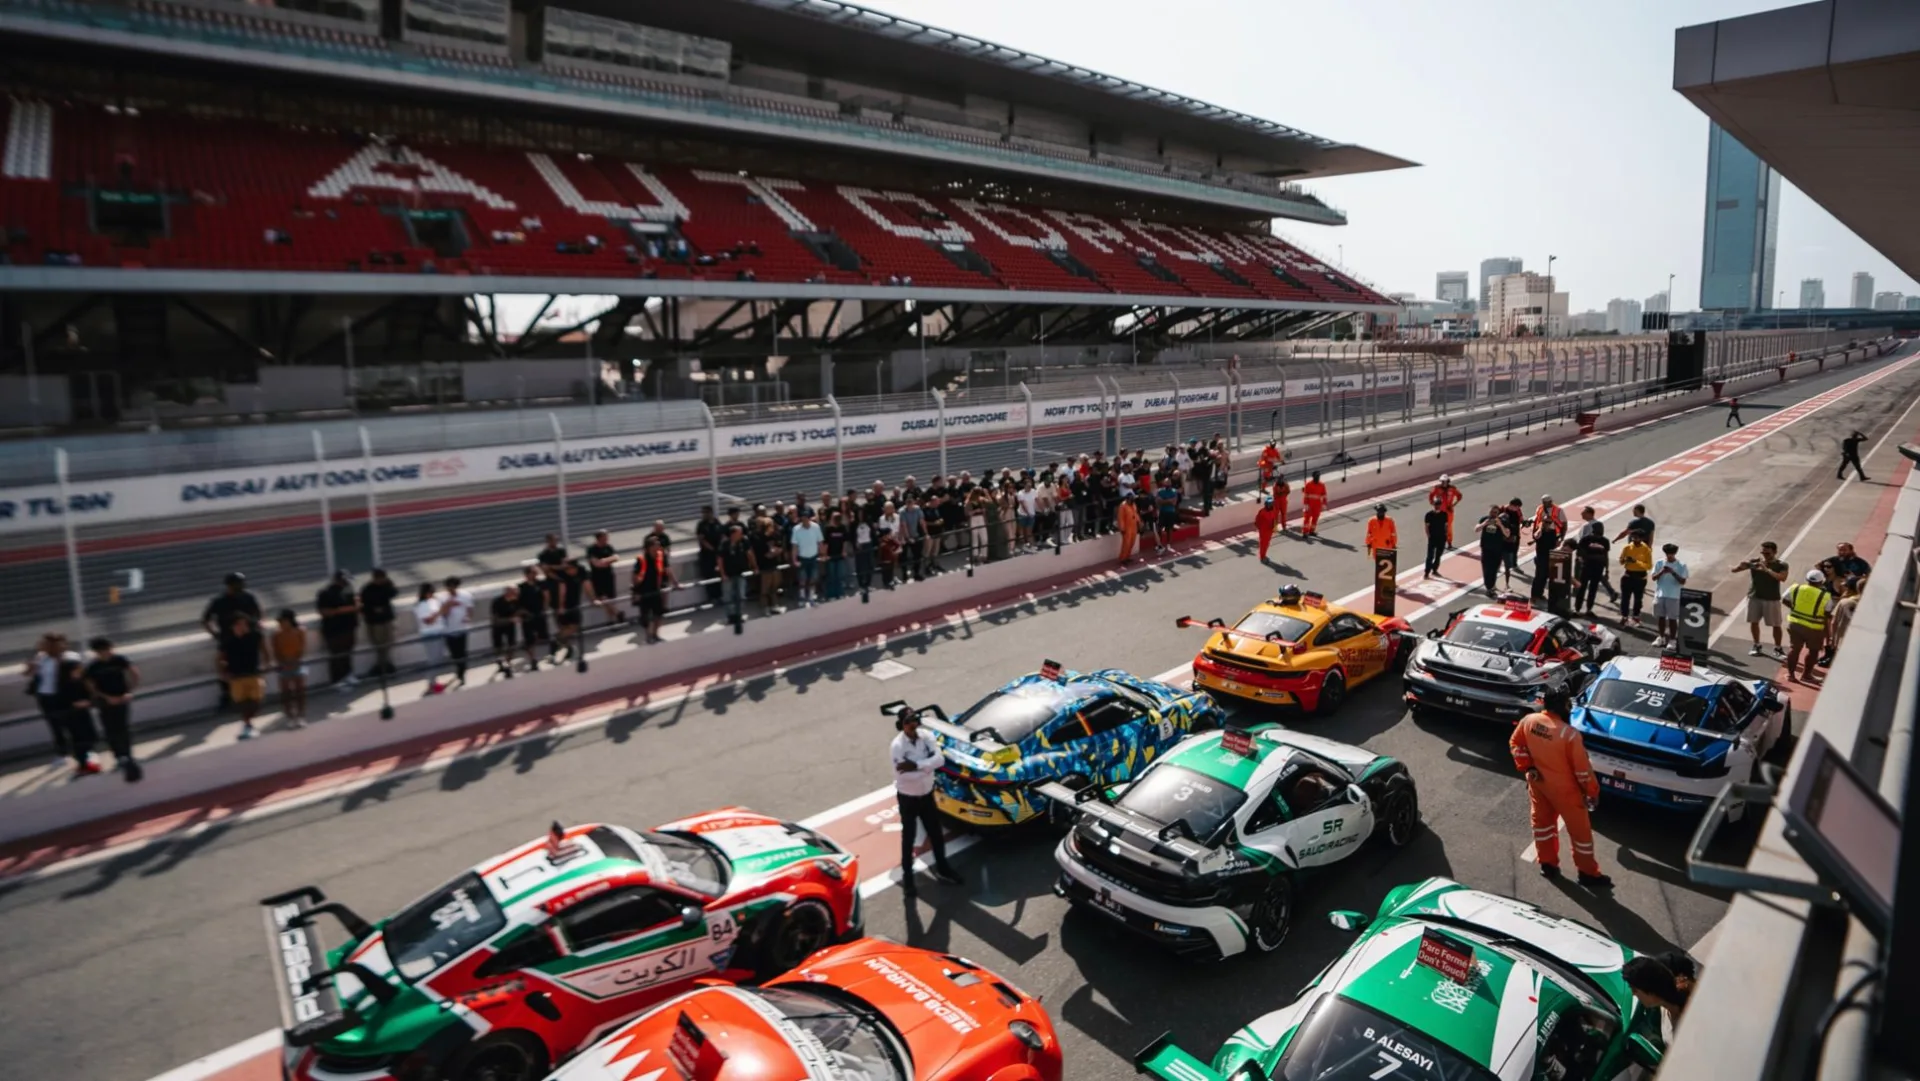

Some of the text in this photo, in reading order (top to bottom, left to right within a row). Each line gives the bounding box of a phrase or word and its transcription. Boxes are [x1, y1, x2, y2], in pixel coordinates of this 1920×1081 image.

[901, 418, 939, 431] DUBAI
[1044, 407, 1067, 418] NOW
[731, 423, 877, 448] NOW IT'S YOUR TURN
[181, 477, 267, 502] DUBAI
[1378, 558, 1394, 580] 2
[1554, 561, 1566, 584] 1
[1684, 602, 1706, 628] 3
[1481, 631, 1496, 641] 2
[1635, 692, 1665, 708] 75
[1647, 688, 1666, 698] LEVI
[1173, 786, 1194, 801] 3
[1323, 817, 1344, 836] SR
[711, 917, 734, 942] 84
[613, 946, 696, 986] الكويت
[1418, 949, 1467, 980] Don't Touch
[1421, 939, 1468, 969] Parc Fermé
[863, 958, 932, 1002] BAHRAIN
[1363, 1026, 1434, 1071] B. ALESAYI
[1368, 1050, 1404, 1080] 7
